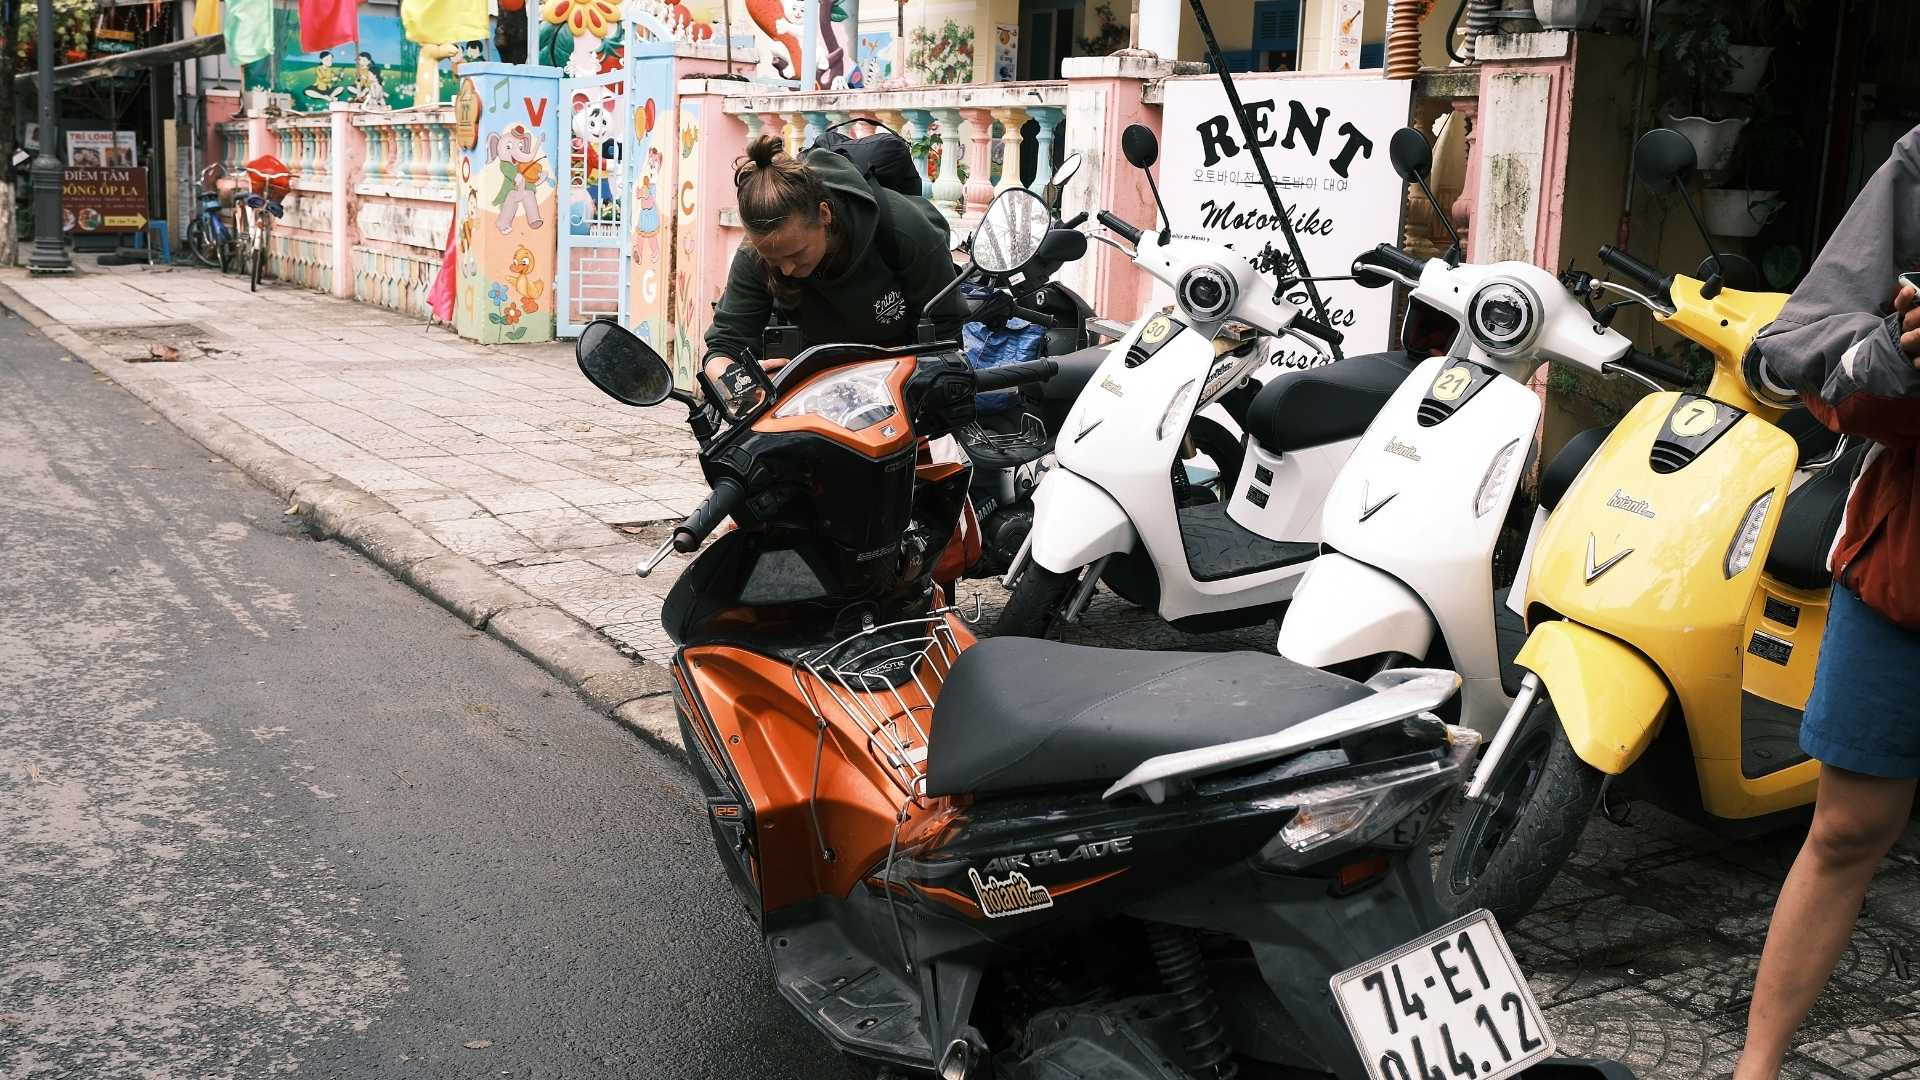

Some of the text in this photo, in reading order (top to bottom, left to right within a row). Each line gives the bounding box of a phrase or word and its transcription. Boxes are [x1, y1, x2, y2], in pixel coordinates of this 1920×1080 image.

[523, 97, 548, 127] V
[1196, 98, 1373, 179] RENT
[1200, 199, 1334, 236] Motorbike
[873, 290, 901, 315] Enter
[1147, 322, 1165, 337] 30
[1438, 374, 1465, 393] 21
[1684, 407, 1704, 426] 7
[982, 836, 1133, 873] AIR BLADE
[970, 872, 1049, 914] hoianit.com
[1362, 931, 1491, 1035] 74-E1
